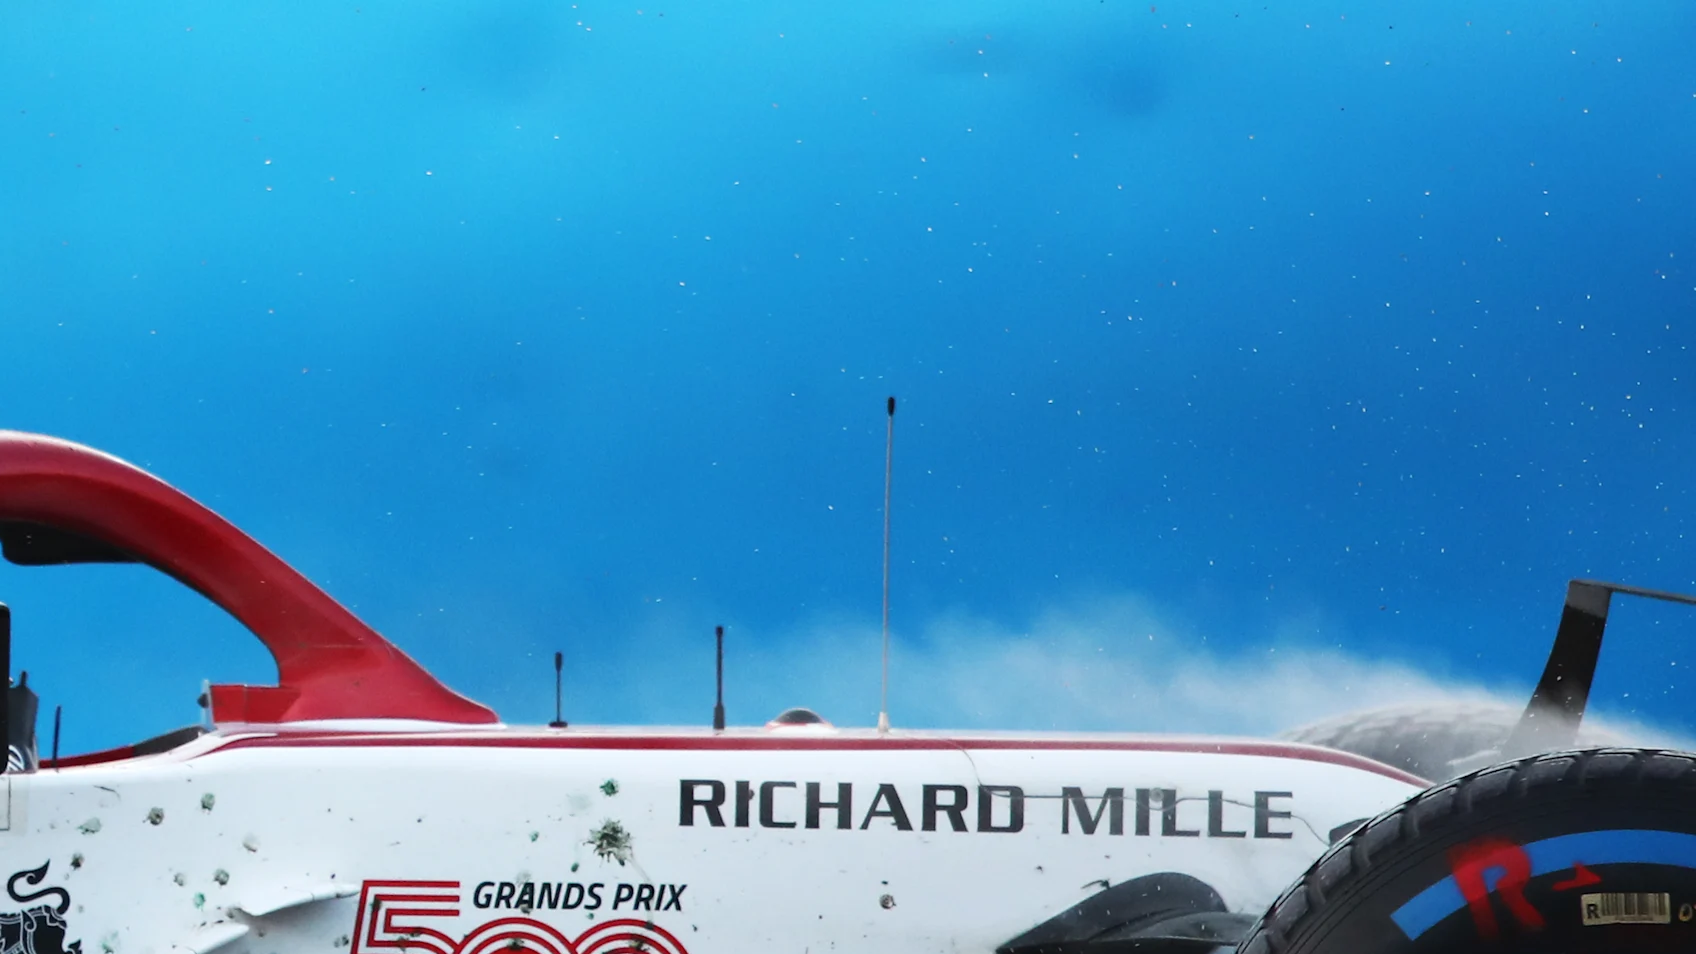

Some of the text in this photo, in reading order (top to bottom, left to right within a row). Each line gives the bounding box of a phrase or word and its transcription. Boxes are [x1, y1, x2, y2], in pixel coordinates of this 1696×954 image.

[680, 780, 1294, 839] RICHARD MILLE
[473, 882, 604, 911] GRANDS
[612, 884, 687, 911] PRIX
